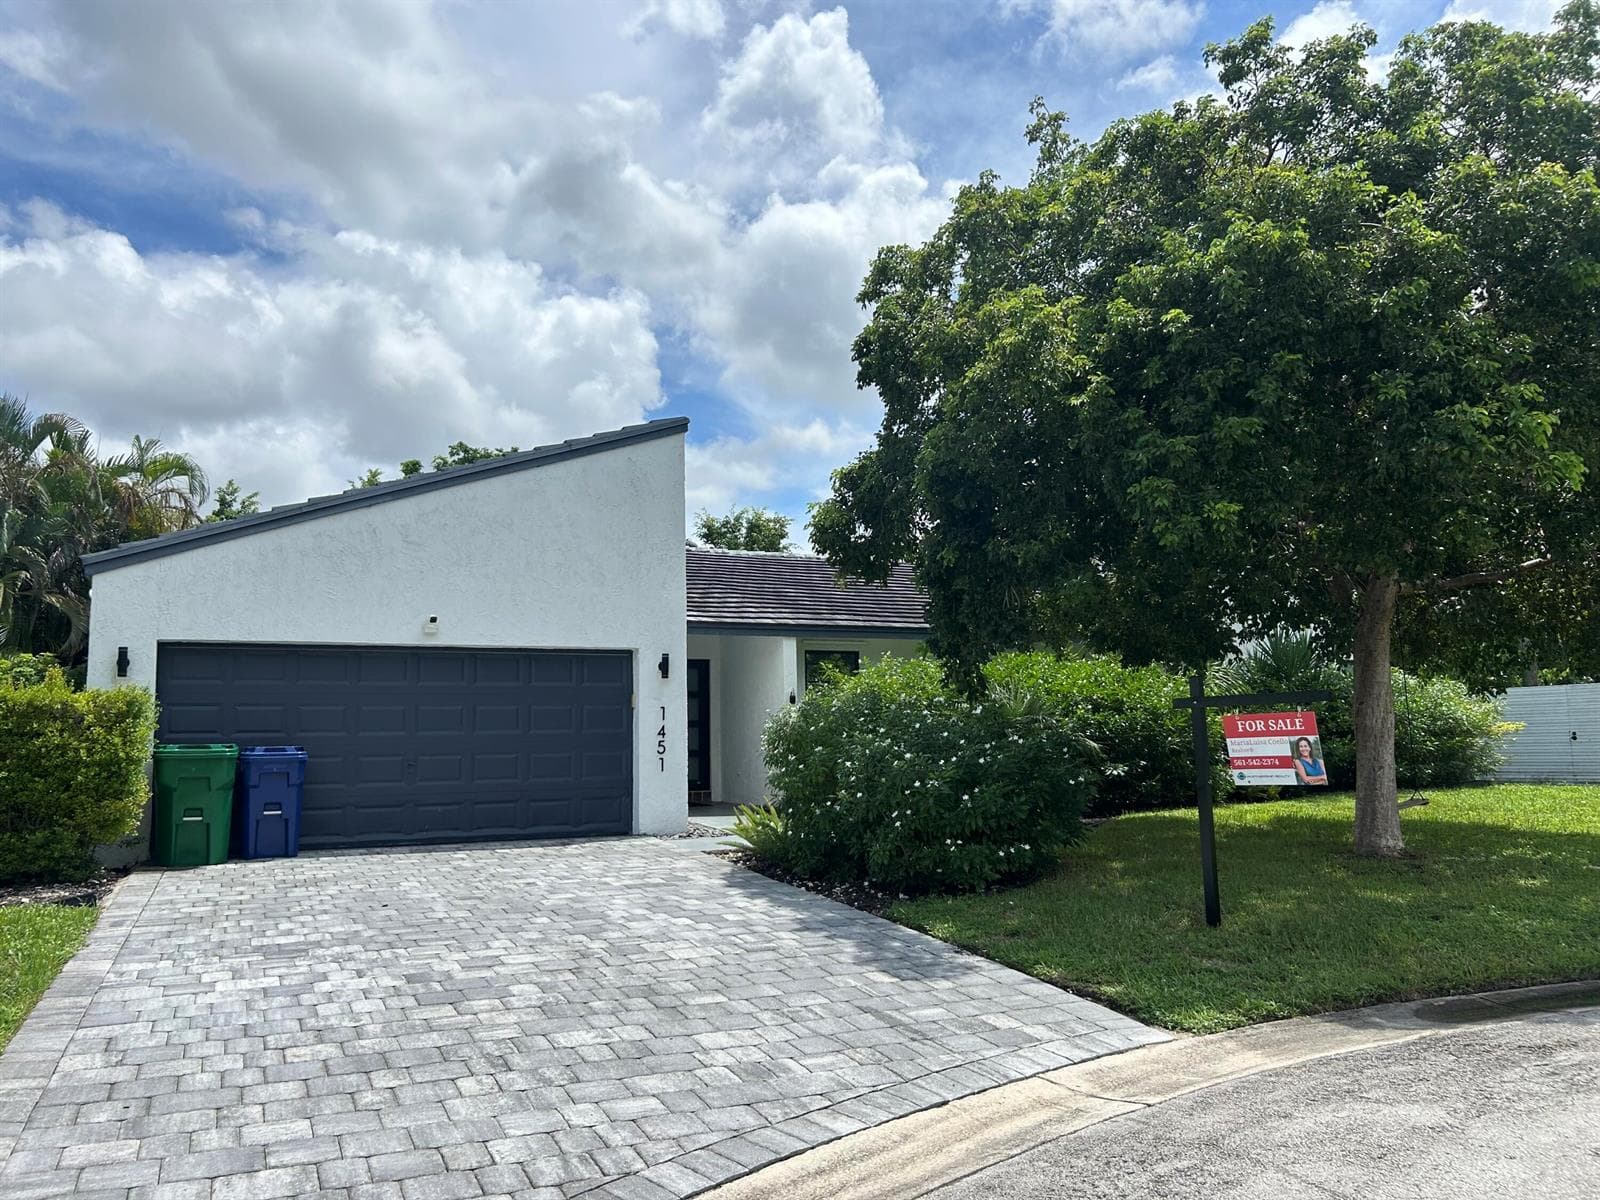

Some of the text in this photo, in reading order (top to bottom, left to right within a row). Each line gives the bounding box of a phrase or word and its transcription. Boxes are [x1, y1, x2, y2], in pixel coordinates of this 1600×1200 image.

[1237, 718, 1305, 732] FOR SALE
[657, 706, 666, 773] 1451
[1233, 758, 1279, 766] 561-542-2374
